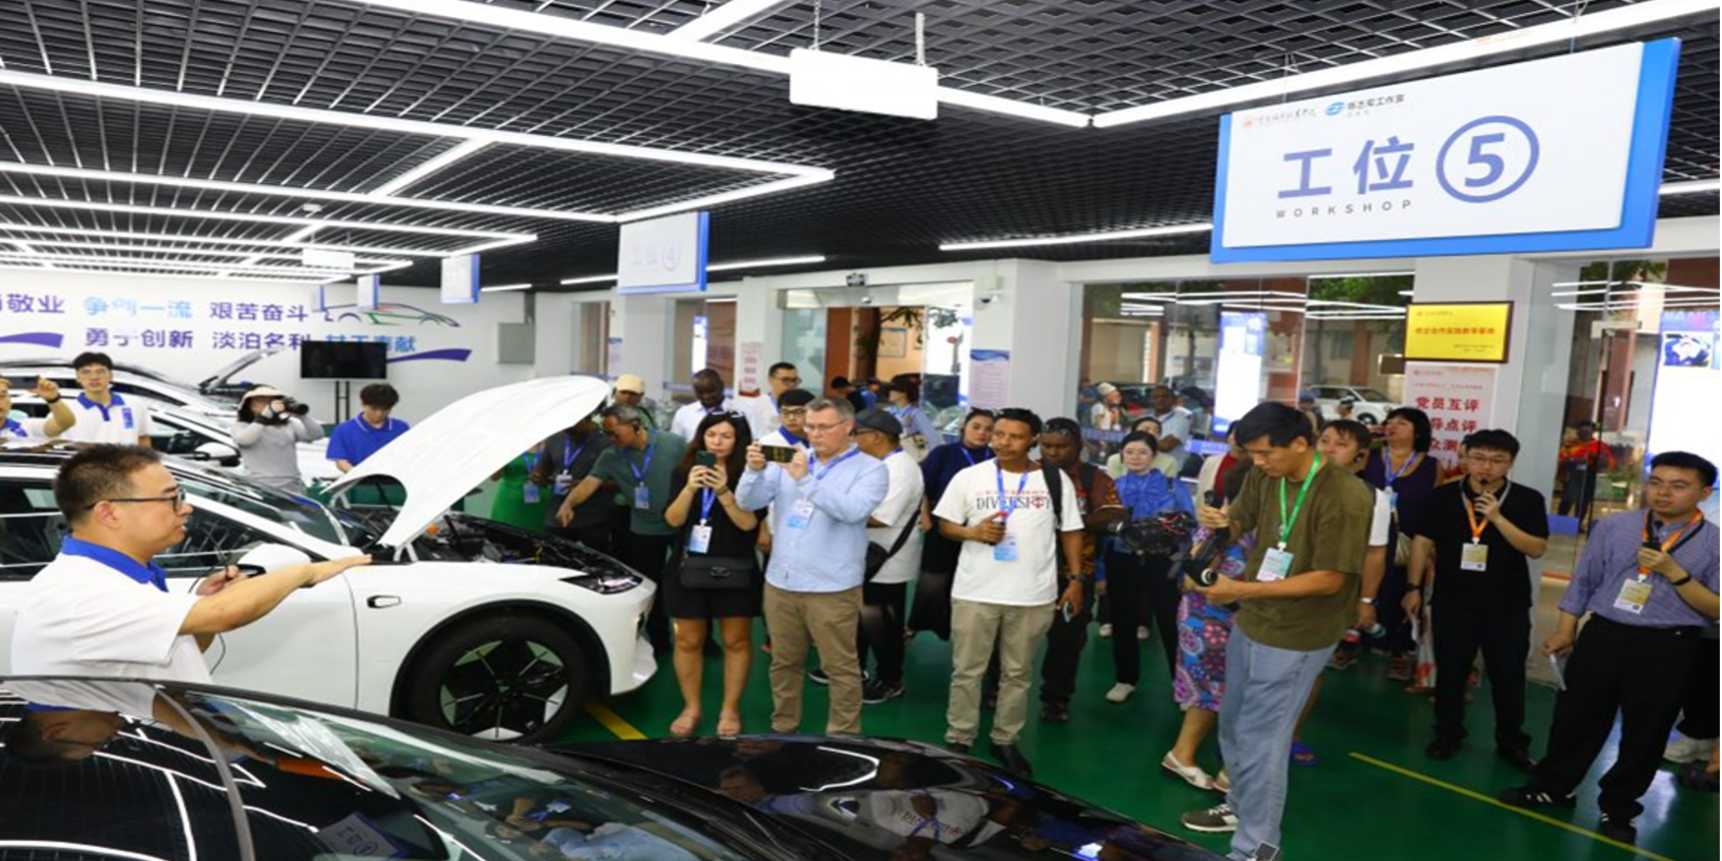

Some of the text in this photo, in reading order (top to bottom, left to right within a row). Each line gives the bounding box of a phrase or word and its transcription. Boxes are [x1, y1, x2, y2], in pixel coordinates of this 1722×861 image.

[1277, 135, 1415, 199] 工位
[1276, 199, 1412, 219] WORKSHOP
[209, 301, 309, 322] 艰苦奋斗
[85, 328, 194, 349] 勇于创新
[1415, 396, 1479, 412] 党员互评
[1430, 417, 1477, 433] 导点评
